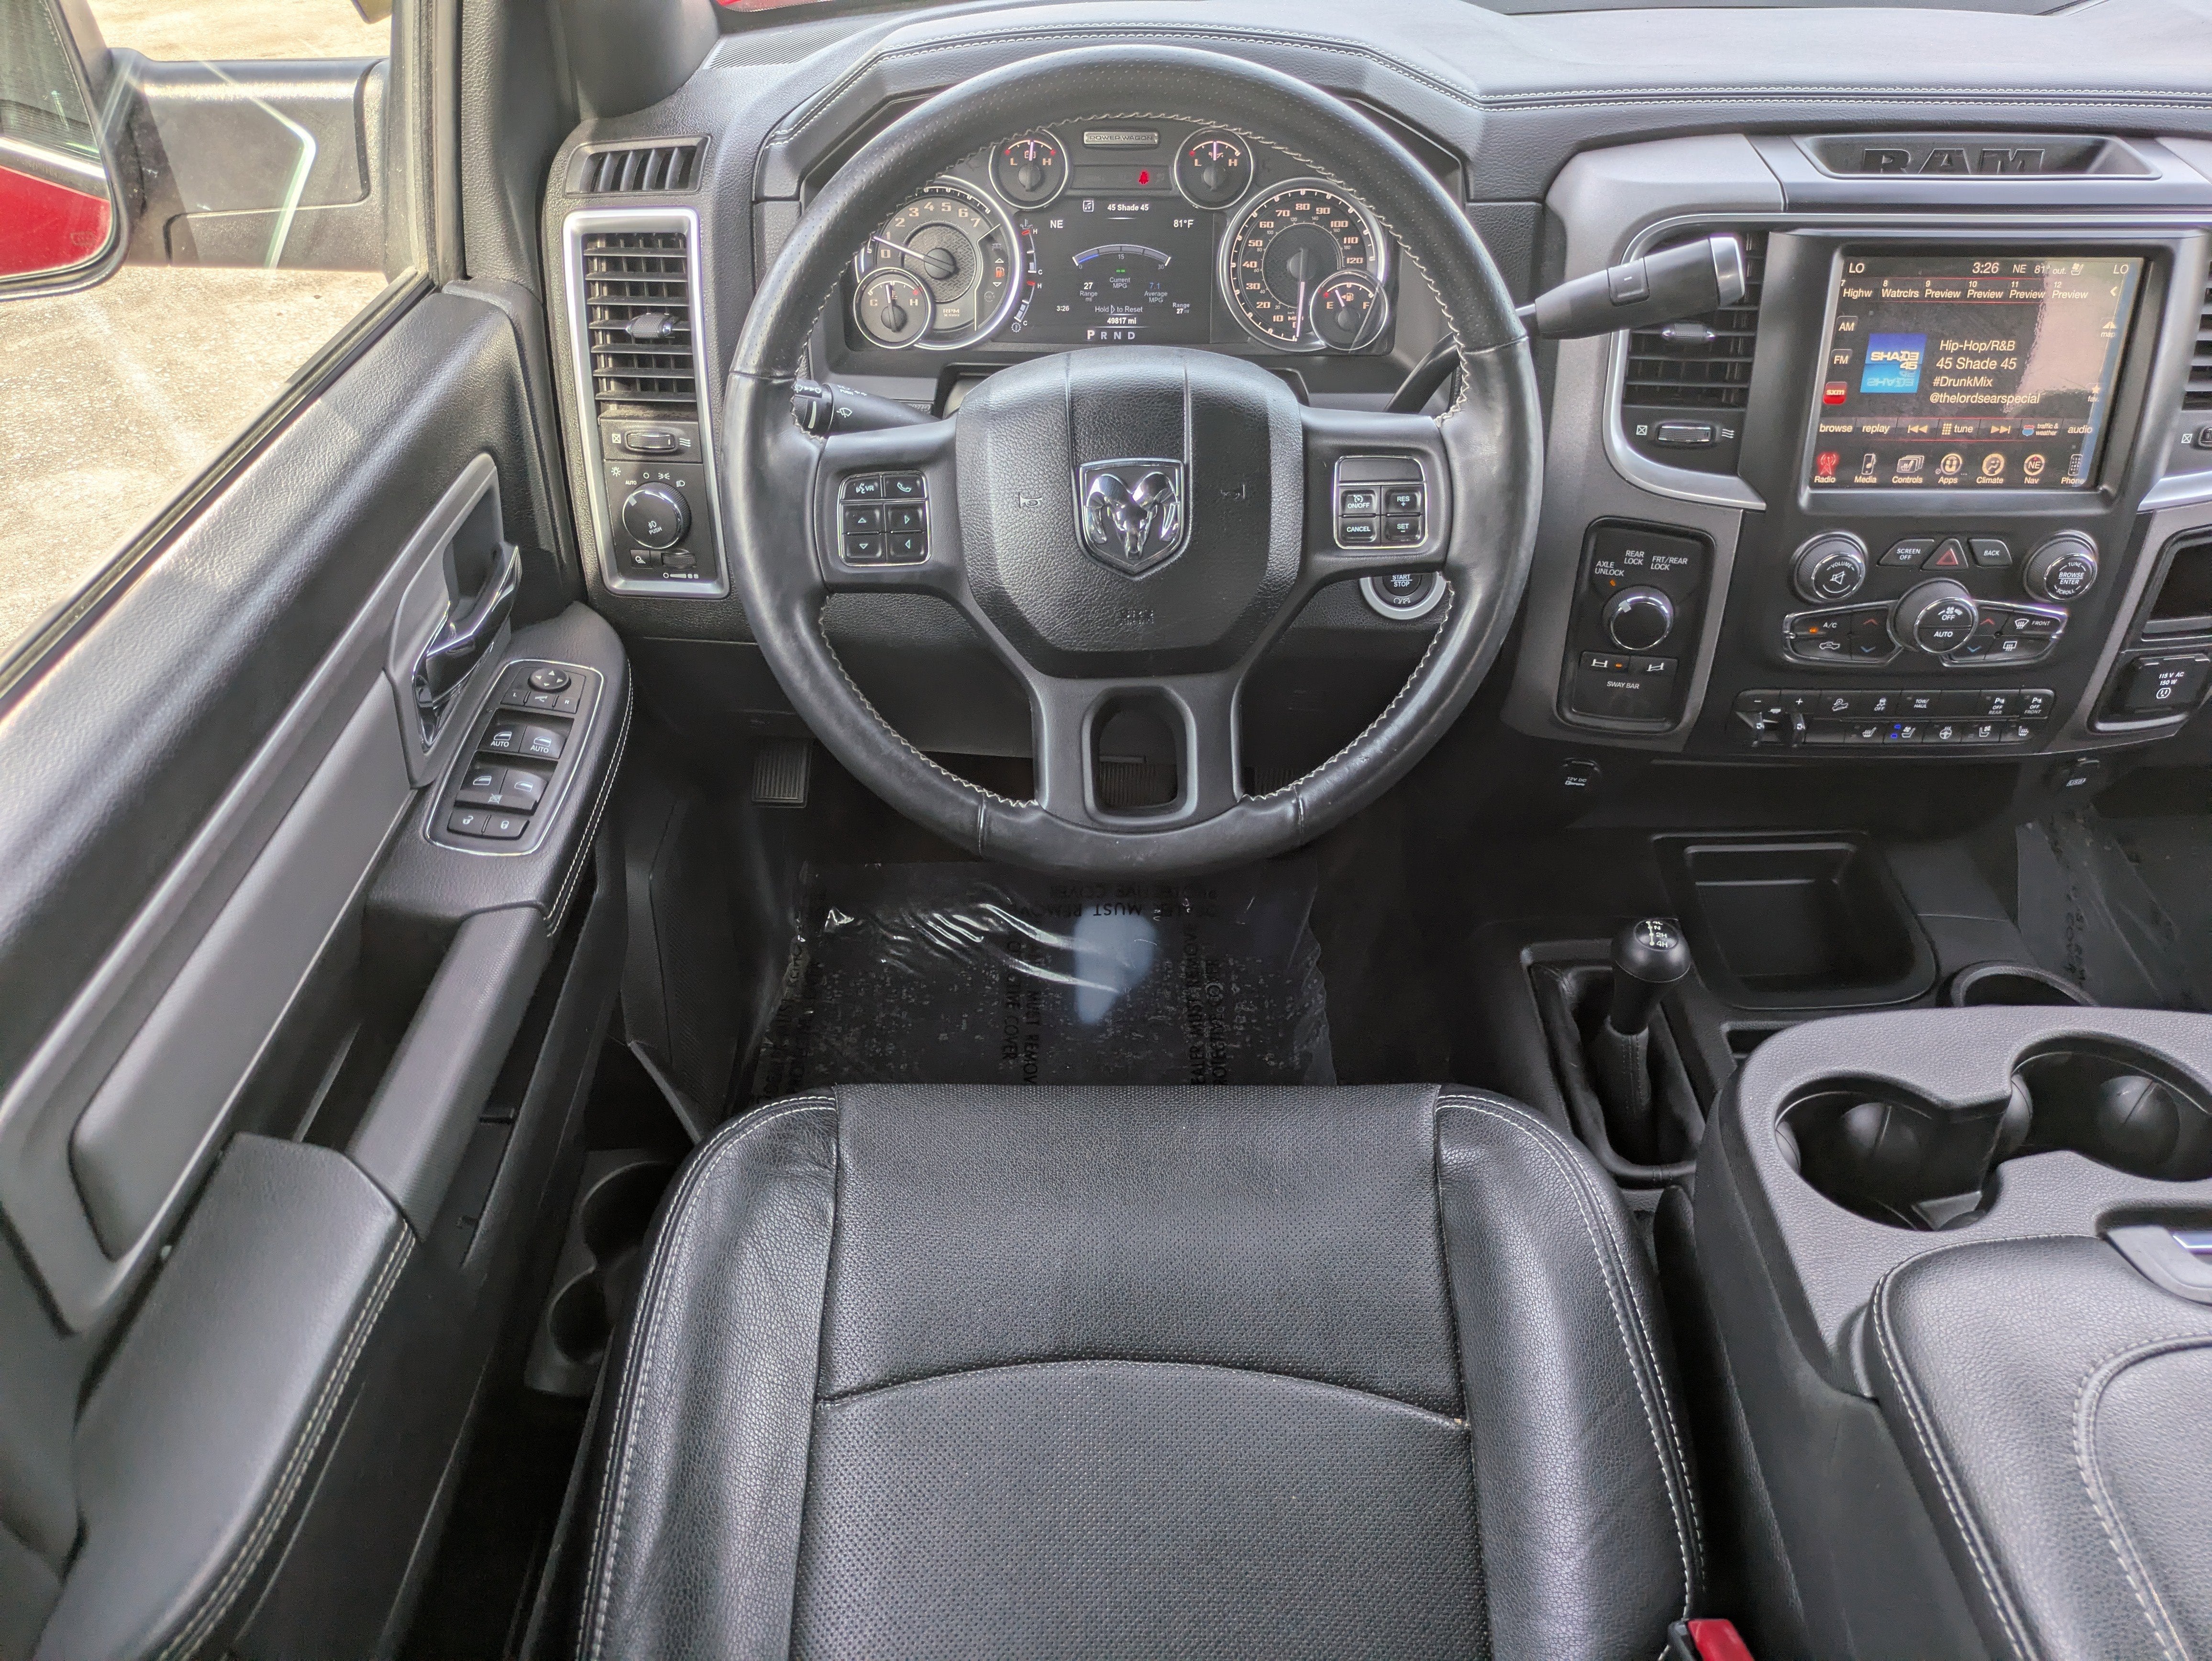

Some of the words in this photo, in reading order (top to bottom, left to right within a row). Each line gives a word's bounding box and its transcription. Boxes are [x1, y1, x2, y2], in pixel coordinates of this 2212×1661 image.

[1863, 148, 2046, 175] RAM
[923, 202, 935, 211] 4
[940, 202, 951, 211] 5
[909, 208, 919, 217] 3
[959, 208, 968, 217] 6
[895, 218, 905, 227] 2
[970, 218, 981, 227] 7
[1051, 220, 1063, 229] NE
[1173, 219, 1194, 228] 81°F
[1849, 263, 1865, 273] LO
[1972, 262, 1999, 274] 3:26
[2013, 265, 2026, 273] NE
[2113, 264, 2129, 274] LO
[1843, 288, 1872, 299] Highw
[1881, 289, 1919, 298] Watrclrs
[1924, 289, 1960, 298] Preview
[1967, 290, 2003, 299] Preview
[2009, 290, 2045, 299] Preview
[2052, 290, 2088, 299] Preview
[1839, 322, 1855, 331] AM
[1087, 330, 1095, 340] P
[1939, 340, 2016, 353] Hip-Hop/R&B
[1833, 355, 1848, 365] FM
[1870, 351, 1919, 362] SHADE
[1900, 362, 1917, 370] 45
[1936, 358, 1952, 369] 45
[1956, 358, 1997, 370] Shade
[2000, 358, 2017, 369] 45
[1933, 376, 1993, 387] #DrunkMix
[1930, 393, 2040, 405] @thelordsearspecial
[1820, 423, 1853, 432] browse
[1862, 424, 1890, 434] replay
[2068, 425, 2093, 433] audio
[1938, 476, 1958, 485] Apps
[649, 526, 663, 535] PUSH
[1652, 556, 1688, 565] FRT/REAR
[1594, 567, 1625, 576] UNLOCK
[1650, 563, 1670, 571] LOCK
[1823, 621, 1838, 630] A/C
[530, 745, 549, 753] AUTO
[1093, 902, 1142, 916] MUST
[1002, 1015, 1020, 1060] COVER
